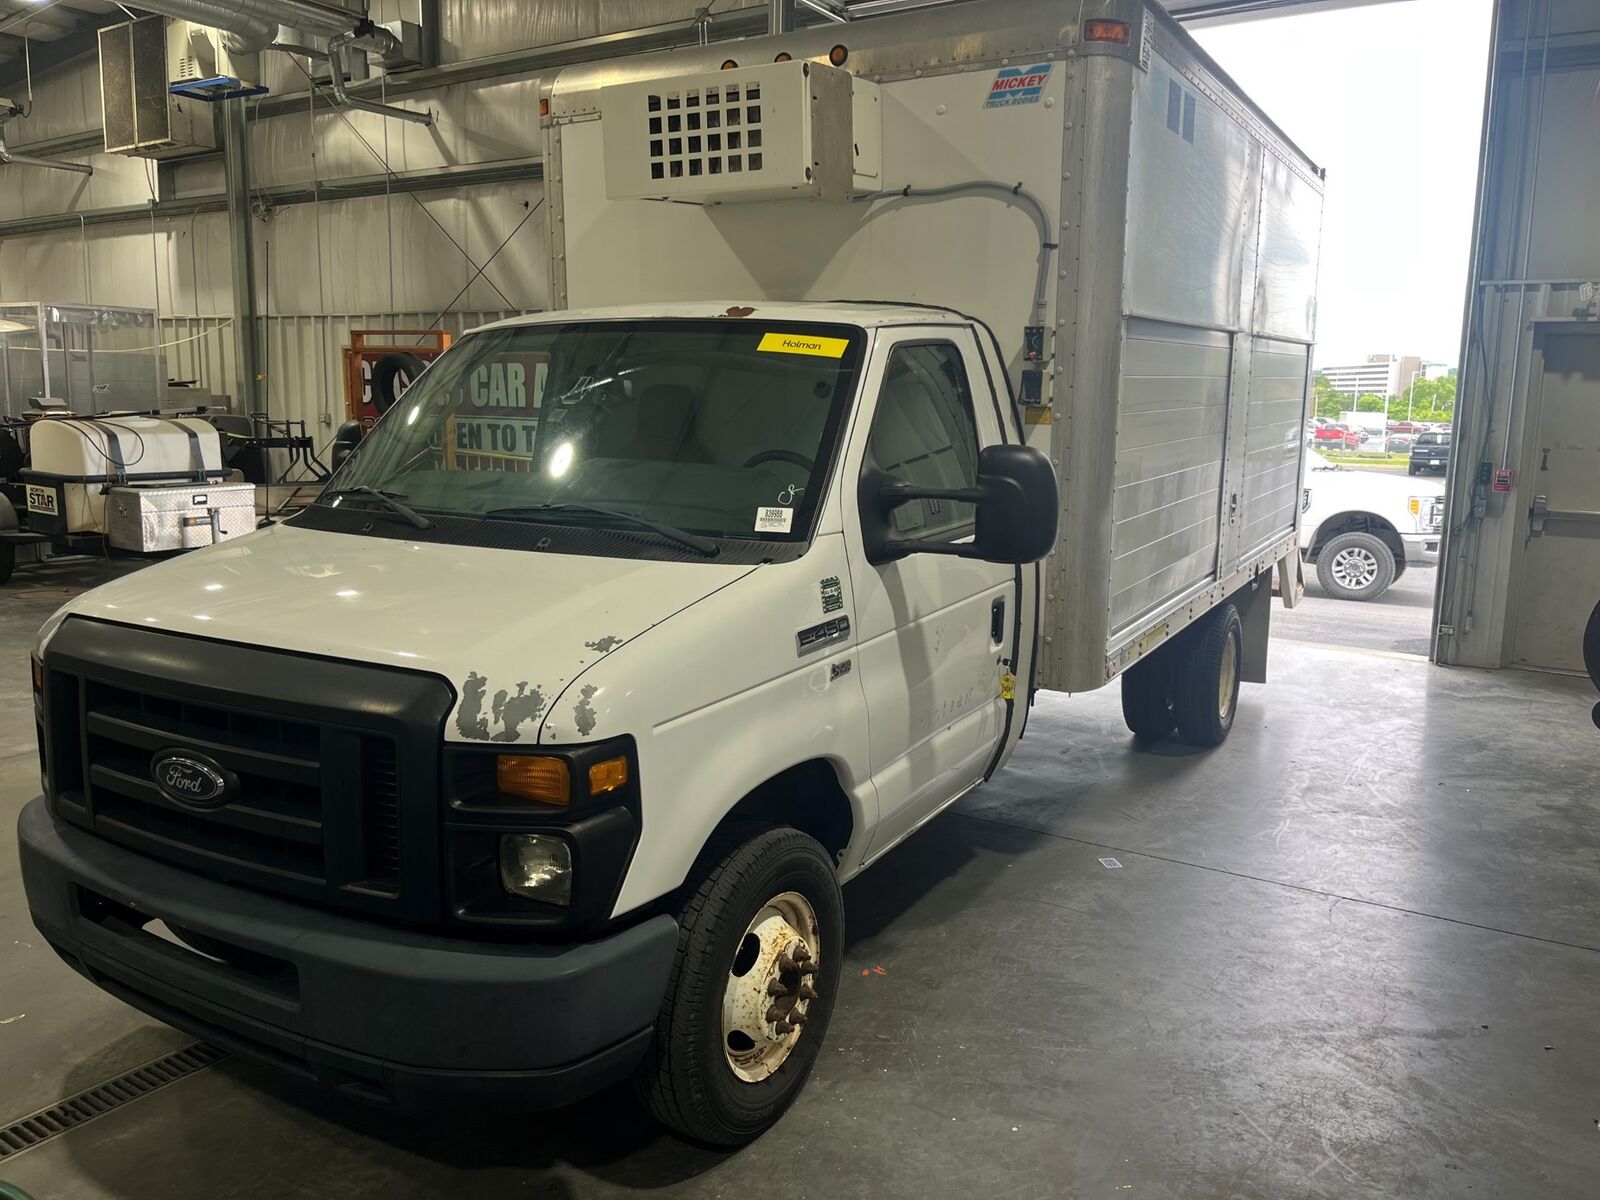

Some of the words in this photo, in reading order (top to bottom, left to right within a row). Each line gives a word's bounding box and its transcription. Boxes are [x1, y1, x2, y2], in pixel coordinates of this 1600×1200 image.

[992, 74, 1047, 90] MICKEY
[986, 100, 1010, 108] TRUCK
[1011, 96, 1040, 105] BODIES
[782, 340, 821, 350] Holman
[470, 363, 527, 408] CAR
[487, 424, 517, 452] TO
[29, 492, 54, 507] STAR
[167, 765, 202, 793] Ford
